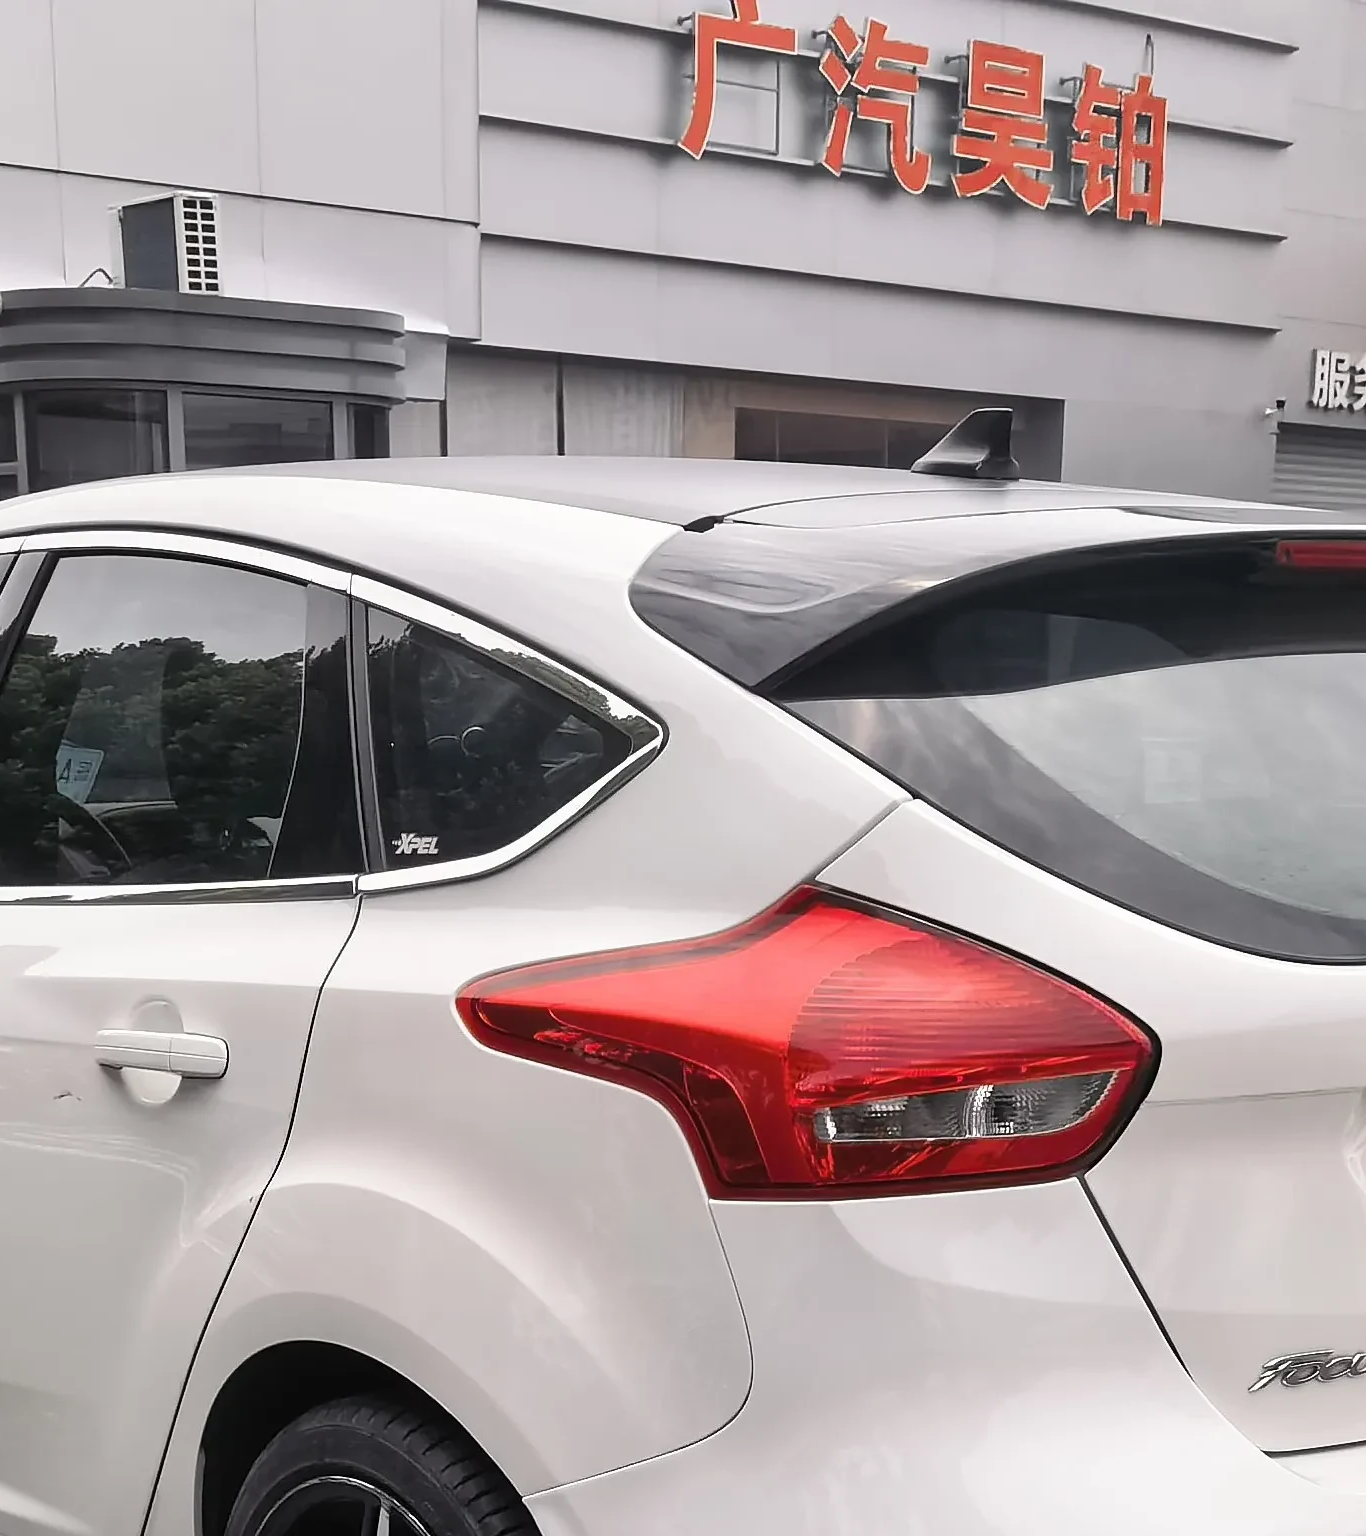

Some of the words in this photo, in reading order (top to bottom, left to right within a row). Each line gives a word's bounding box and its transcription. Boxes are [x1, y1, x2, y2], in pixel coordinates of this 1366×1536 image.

[677, 0, 1168, 227] 广汽昊铂
[393, 833, 439, 855] XPEL
